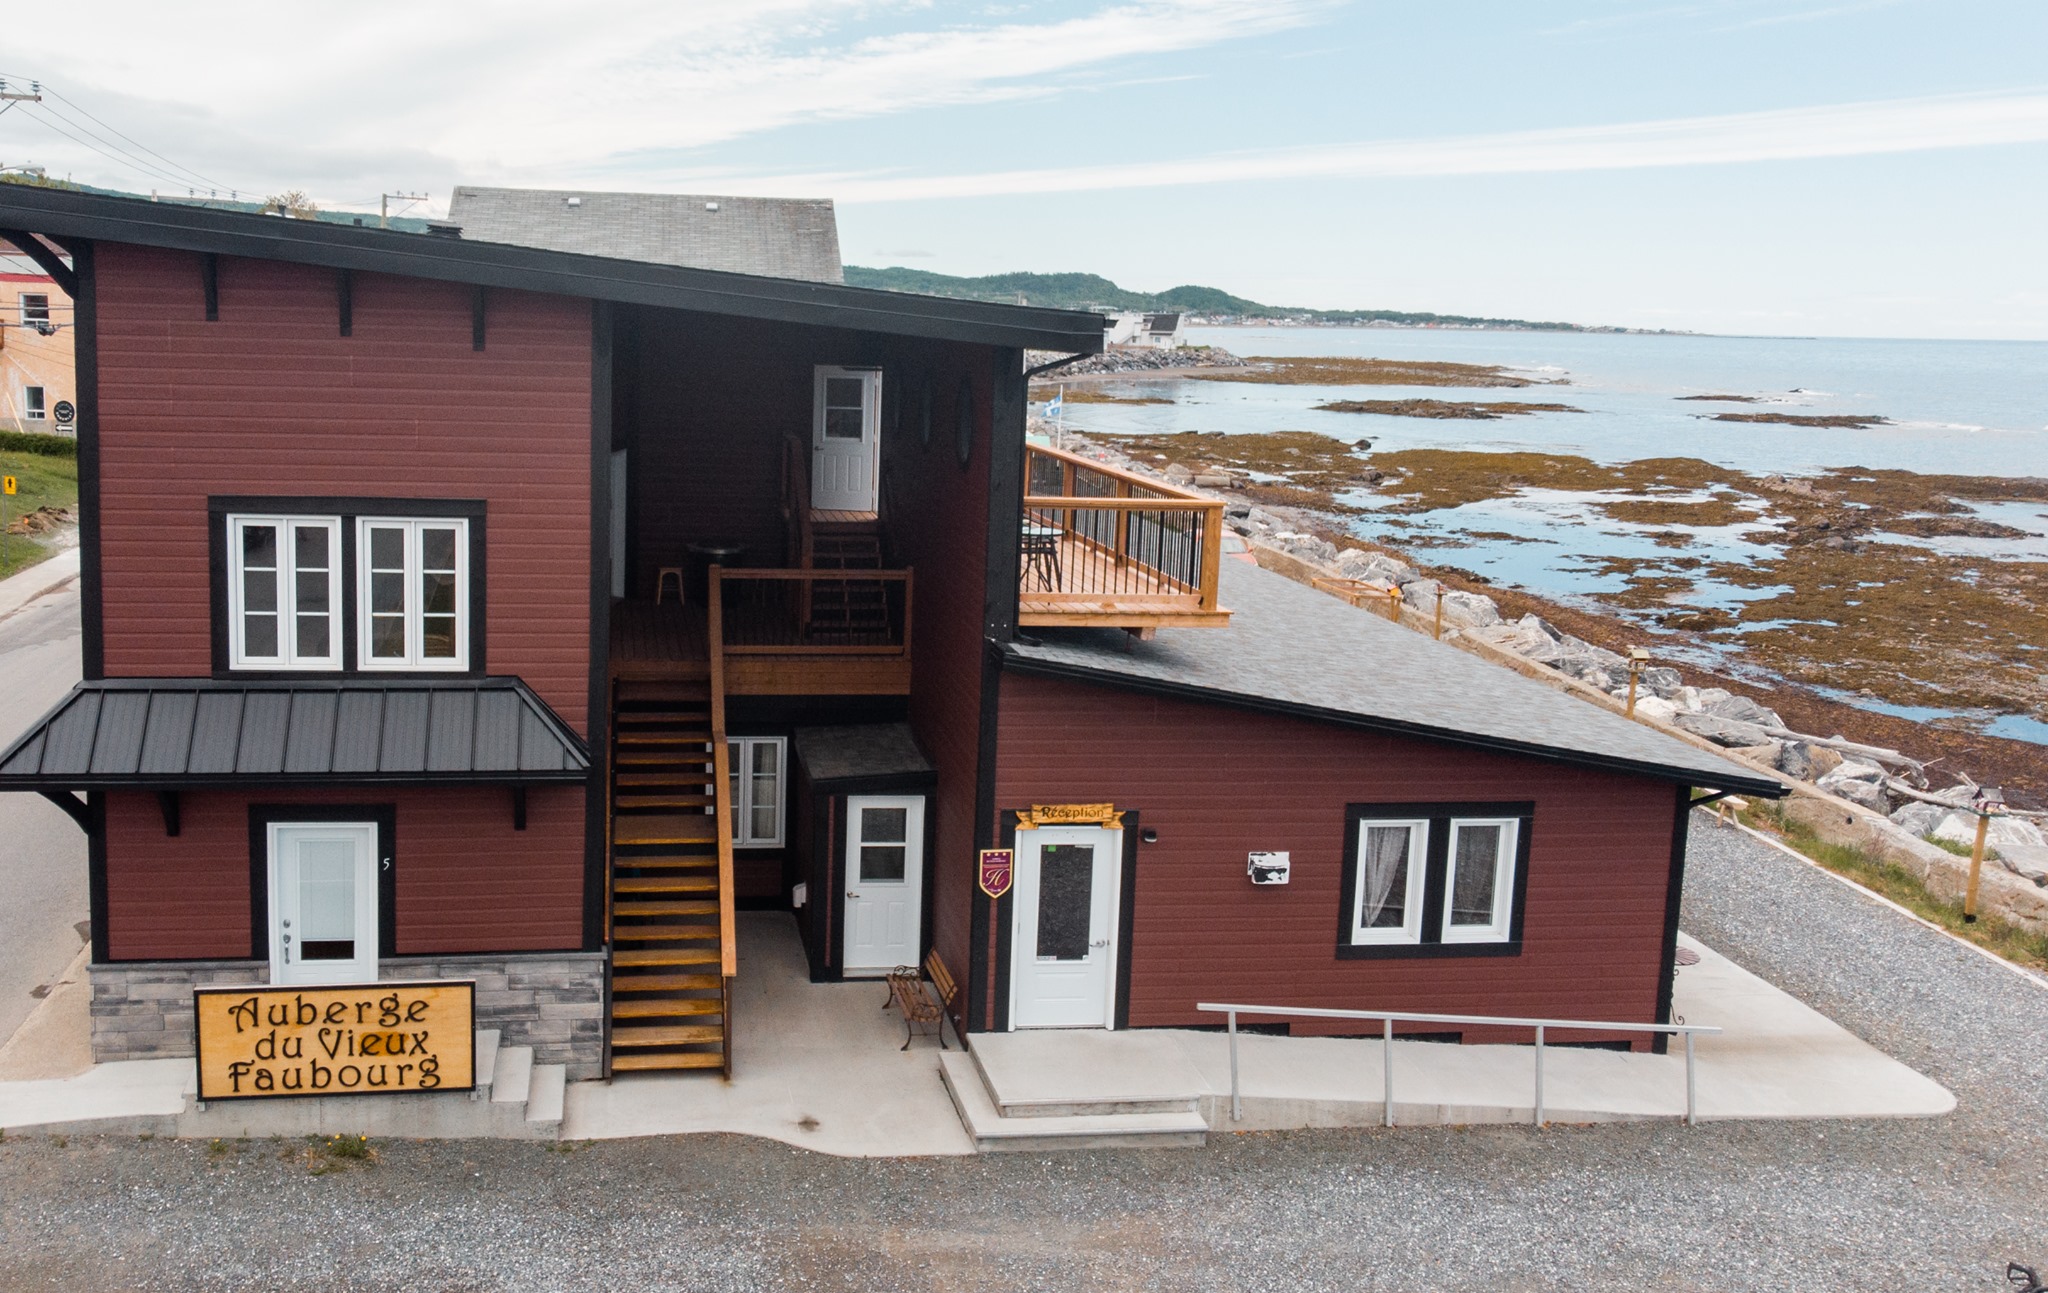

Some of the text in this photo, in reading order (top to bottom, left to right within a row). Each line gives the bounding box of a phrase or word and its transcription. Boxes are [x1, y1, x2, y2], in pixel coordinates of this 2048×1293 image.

[1041, 805, 1104, 819] Réception
[383, 857, 390, 871] 5
[228, 993, 430, 1033] Auberge
[254, 1027, 430, 1060] du Vieux
[228, 1054, 442, 1093] Faubourg
